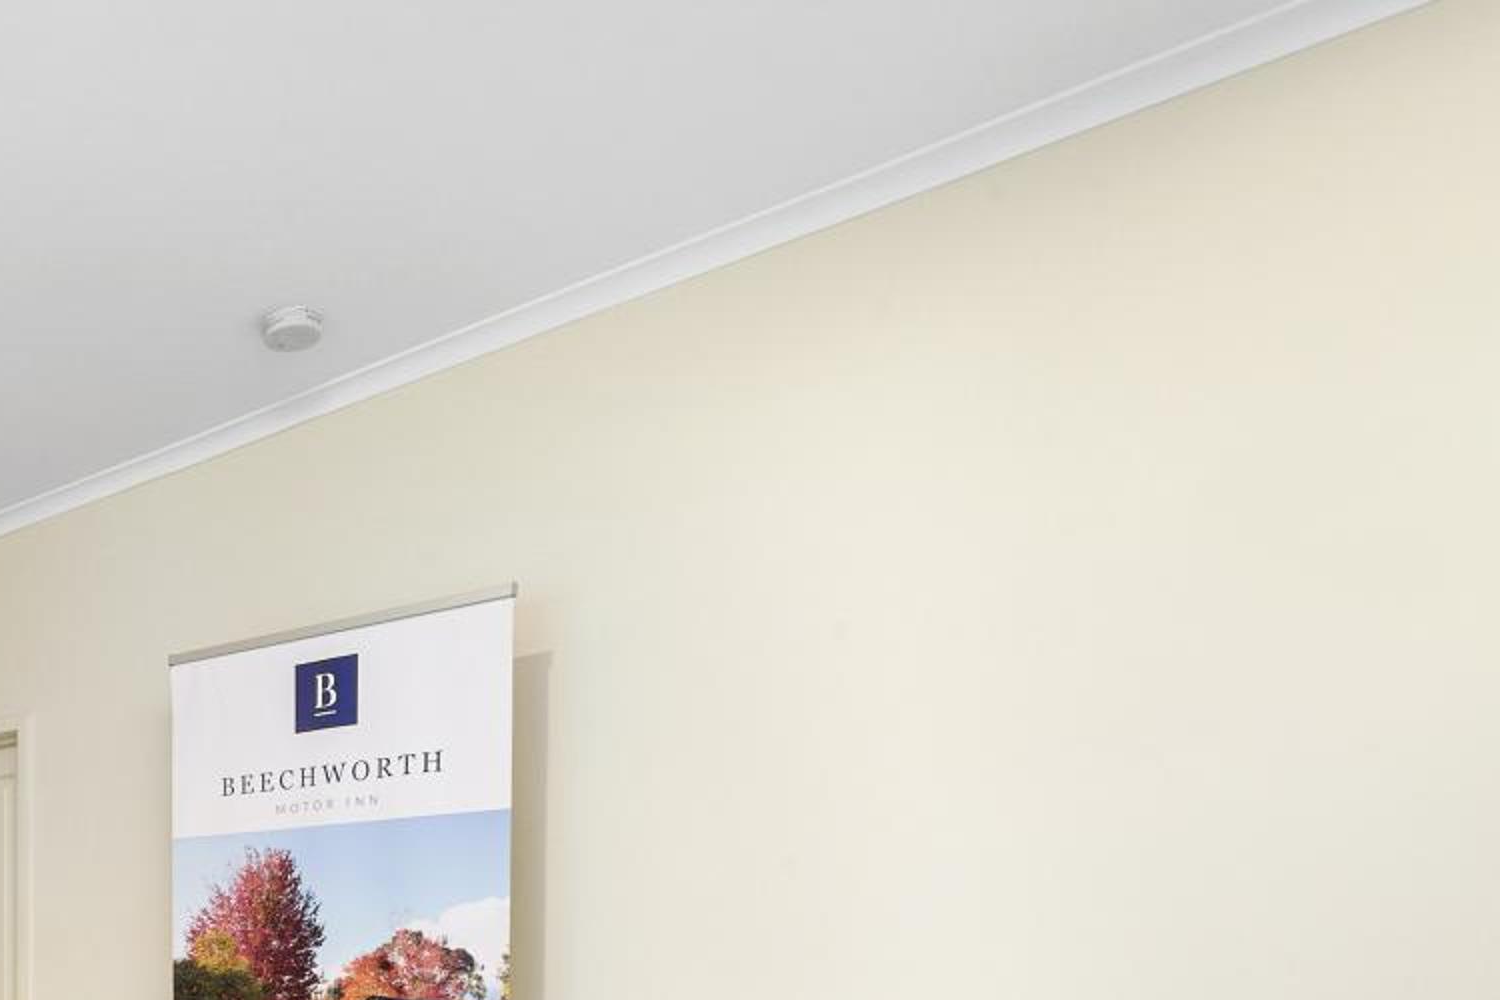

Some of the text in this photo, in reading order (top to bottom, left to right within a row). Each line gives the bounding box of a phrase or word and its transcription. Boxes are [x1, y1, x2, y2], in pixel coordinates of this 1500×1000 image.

[315, 672, 337, 709] B
[222, 749, 443, 796] BEECHWORTH
[275, 794, 380, 815] MOTOR INN
